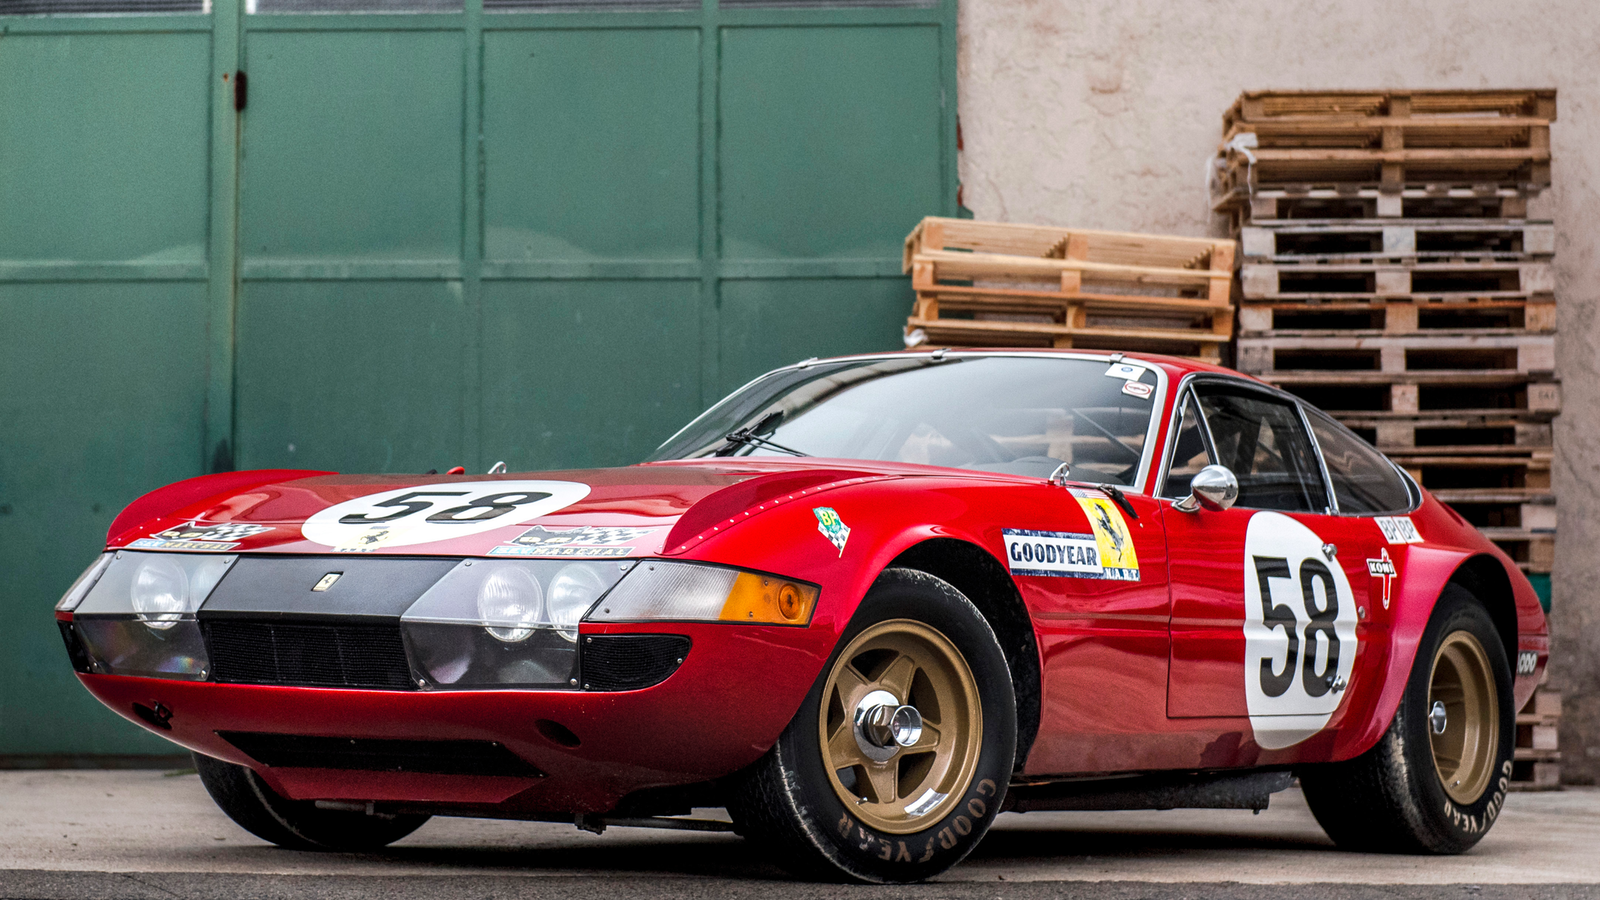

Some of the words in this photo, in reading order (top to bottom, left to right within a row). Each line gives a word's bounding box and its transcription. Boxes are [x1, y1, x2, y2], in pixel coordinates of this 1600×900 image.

[338, 491, 553, 524] 58
[819, 511, 838, 526] BP
[1380, 520, 1398, 541] BP
[1398, 520, 1416, 540] BP
[161, 541, 229, 550] MARCHAL
[532, 547, 625, 555] MARCHAL
[1010, 541, 1098, 566] GOODYEAR
[1369, 561, 1395, 574] KONI
[1252, 555, 1341, 698] 58
